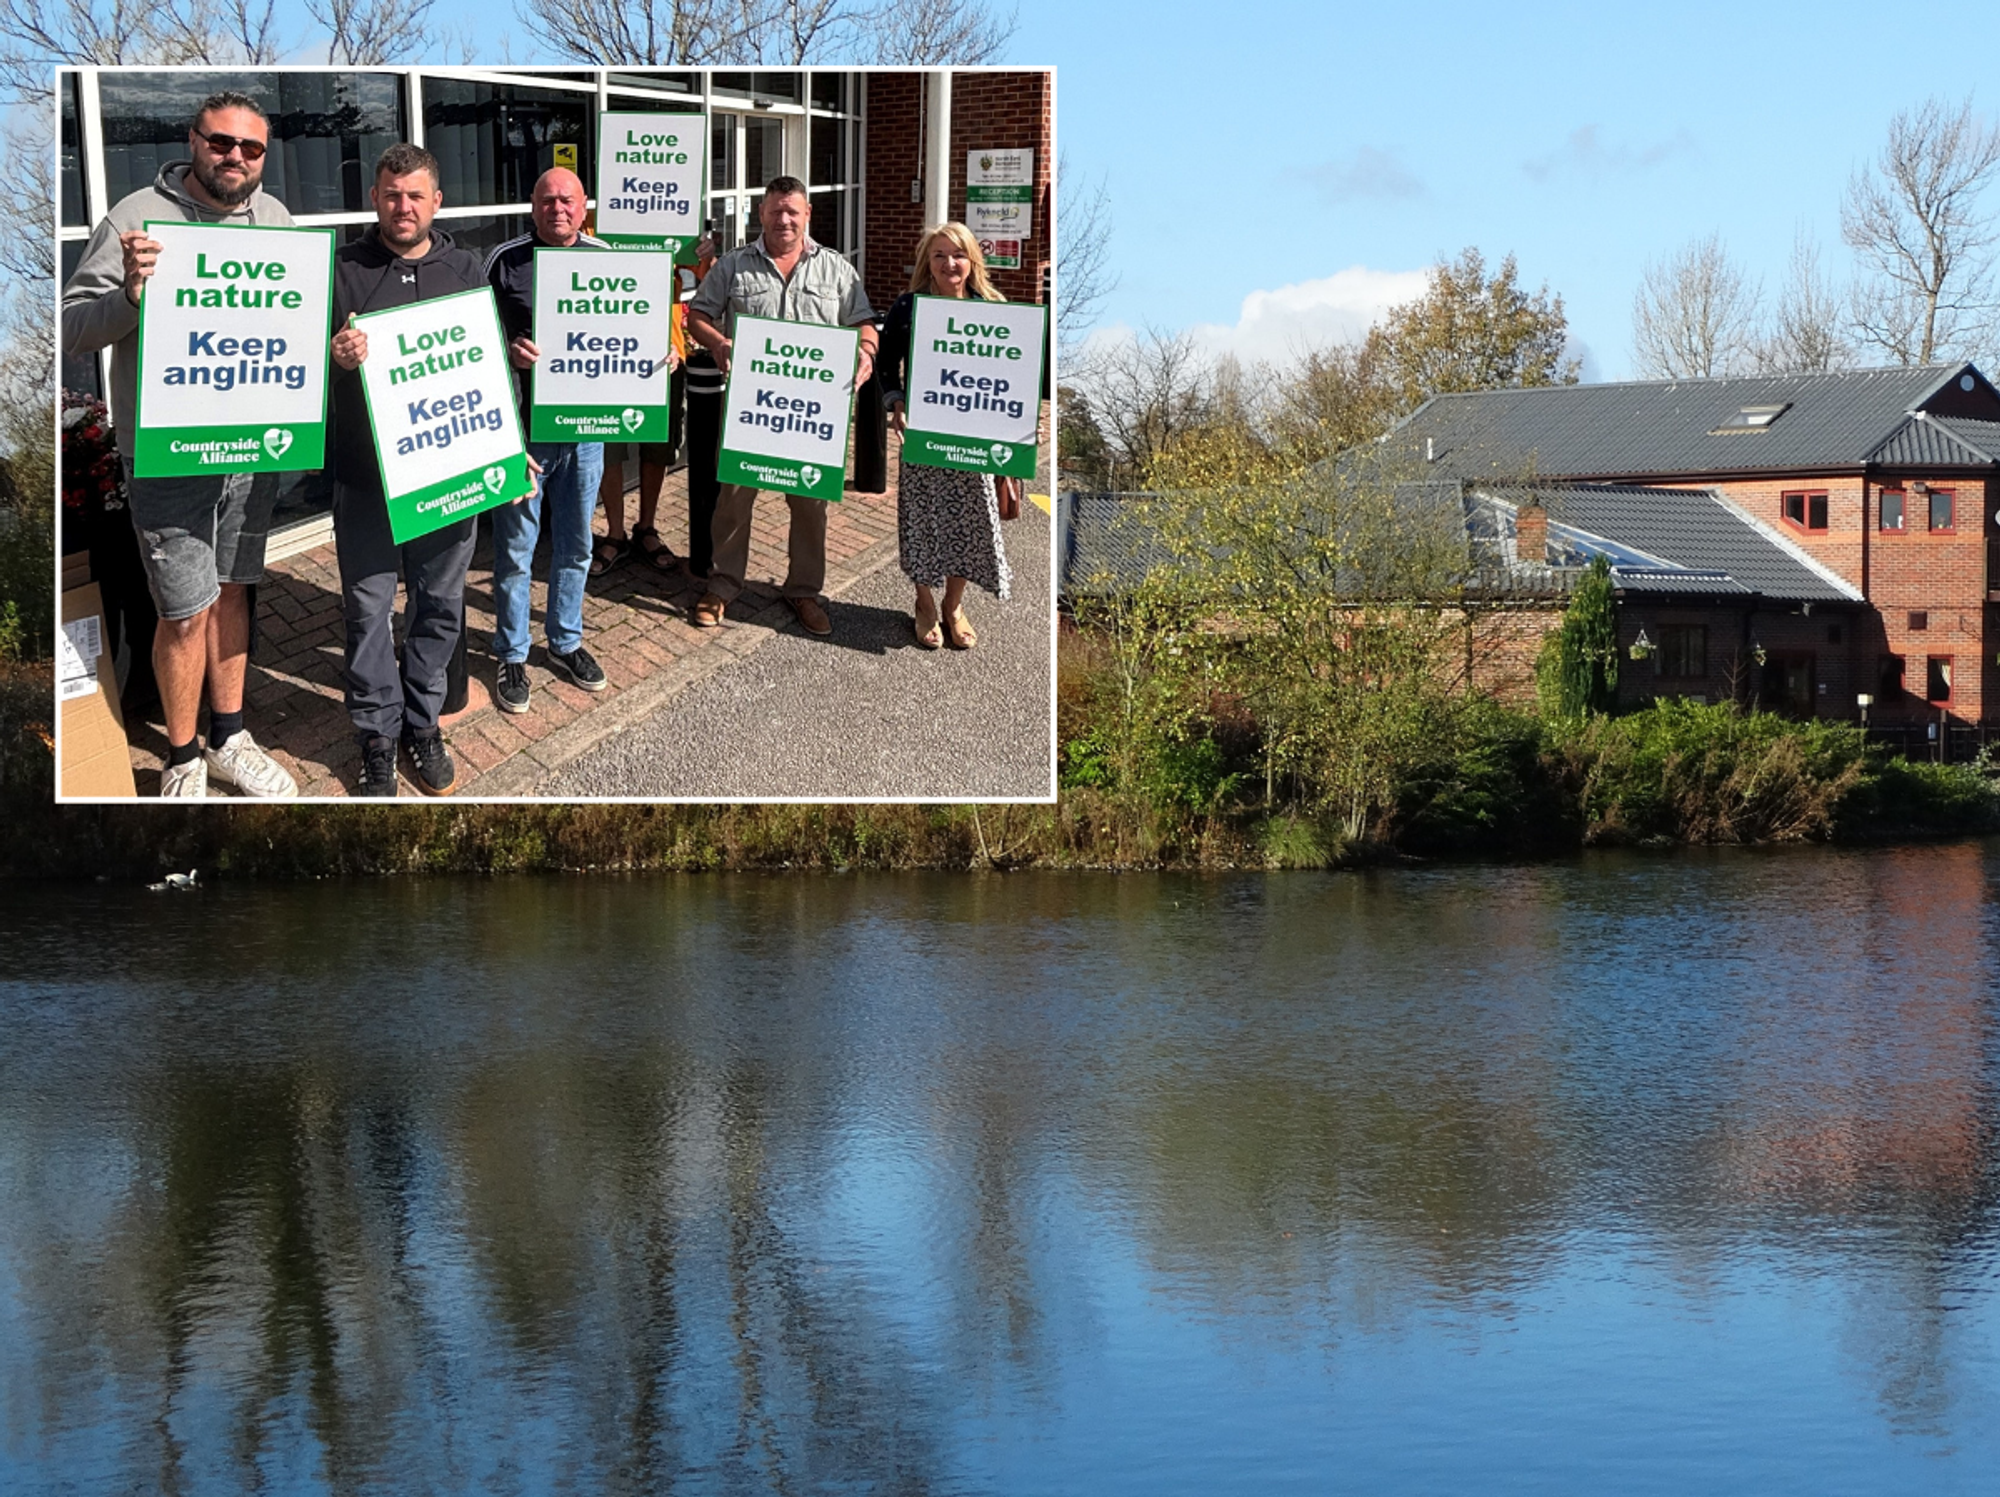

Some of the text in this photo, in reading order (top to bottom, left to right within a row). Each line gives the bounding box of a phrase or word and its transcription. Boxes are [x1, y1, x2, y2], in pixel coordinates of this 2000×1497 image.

[627, 130, 678, 146] Love
[615, 149, 687, 164] nature
[622, 177, 678, 197] Keep
[609, 196, 689, 214] angling
[196, 253, 286, 281] Love
[571, 272, 637, 292] Love
[176, 283, 302, 309] nature
[557, 294, 650, 315] nature
[397, 324, 466, 357] Love
[946, 317, 1011, 340] Love
[188, 331, 287, 360] Keep
[566, 332, 639, 357] Keep
[764, 337, 824, 362] Love
[932, 336, 1022, 361] nature
[163, 359, 306, 390] angling
[389, 343, 484, 386] nature
[549, 354, 653, 378] angling
[750, 357, 835, 384] nature
[939, 369, 1010, 396] Keep
[407, 388, 483, 426] Keep
[755, 389, 822, 418] Keep
[923, 390, 1024, 419] angling
[396, 404, 503, 456] angling
[555, 414, 620, 427] Countryside
[575, 424, 620, 435] Alliance
[739, 410, 834, 441] angling
[170, 438, 260, 455] Countryside
[198, 450, 260, 465] Alliance
[926, 441, 988, 457] Countryside
[740, 461, 799, 479] Countryside
[944, 452, 988, 467] Alliance
[757, 471, 799, 486] Alliance
[416, 481, 484, 514] Countryside
[440, 491, 486, 517] Alliance
